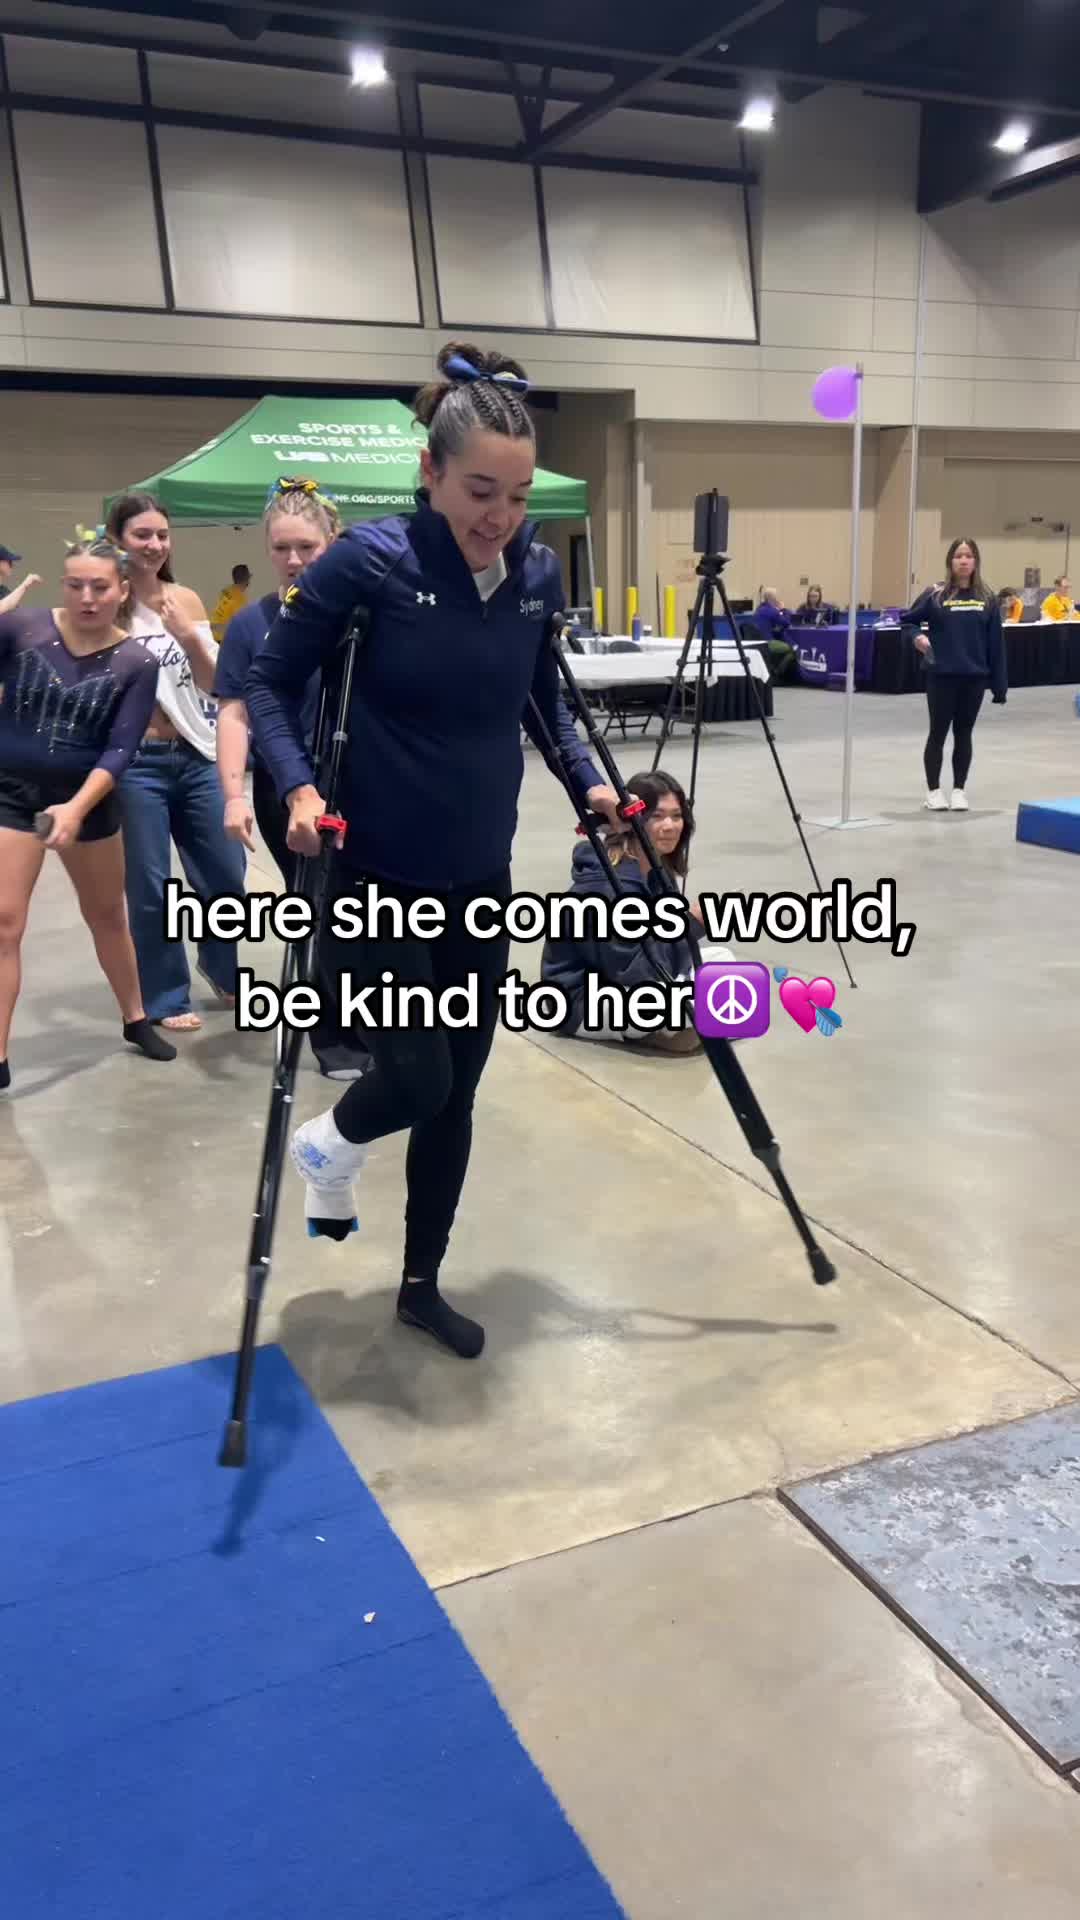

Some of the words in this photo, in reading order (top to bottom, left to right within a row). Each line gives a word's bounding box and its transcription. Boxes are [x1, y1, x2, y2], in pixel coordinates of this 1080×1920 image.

[298, 422, 383, 435] SPORTS
[386, 424, 402, 435] &
[250, 434, 354, 447] EXERCISE
